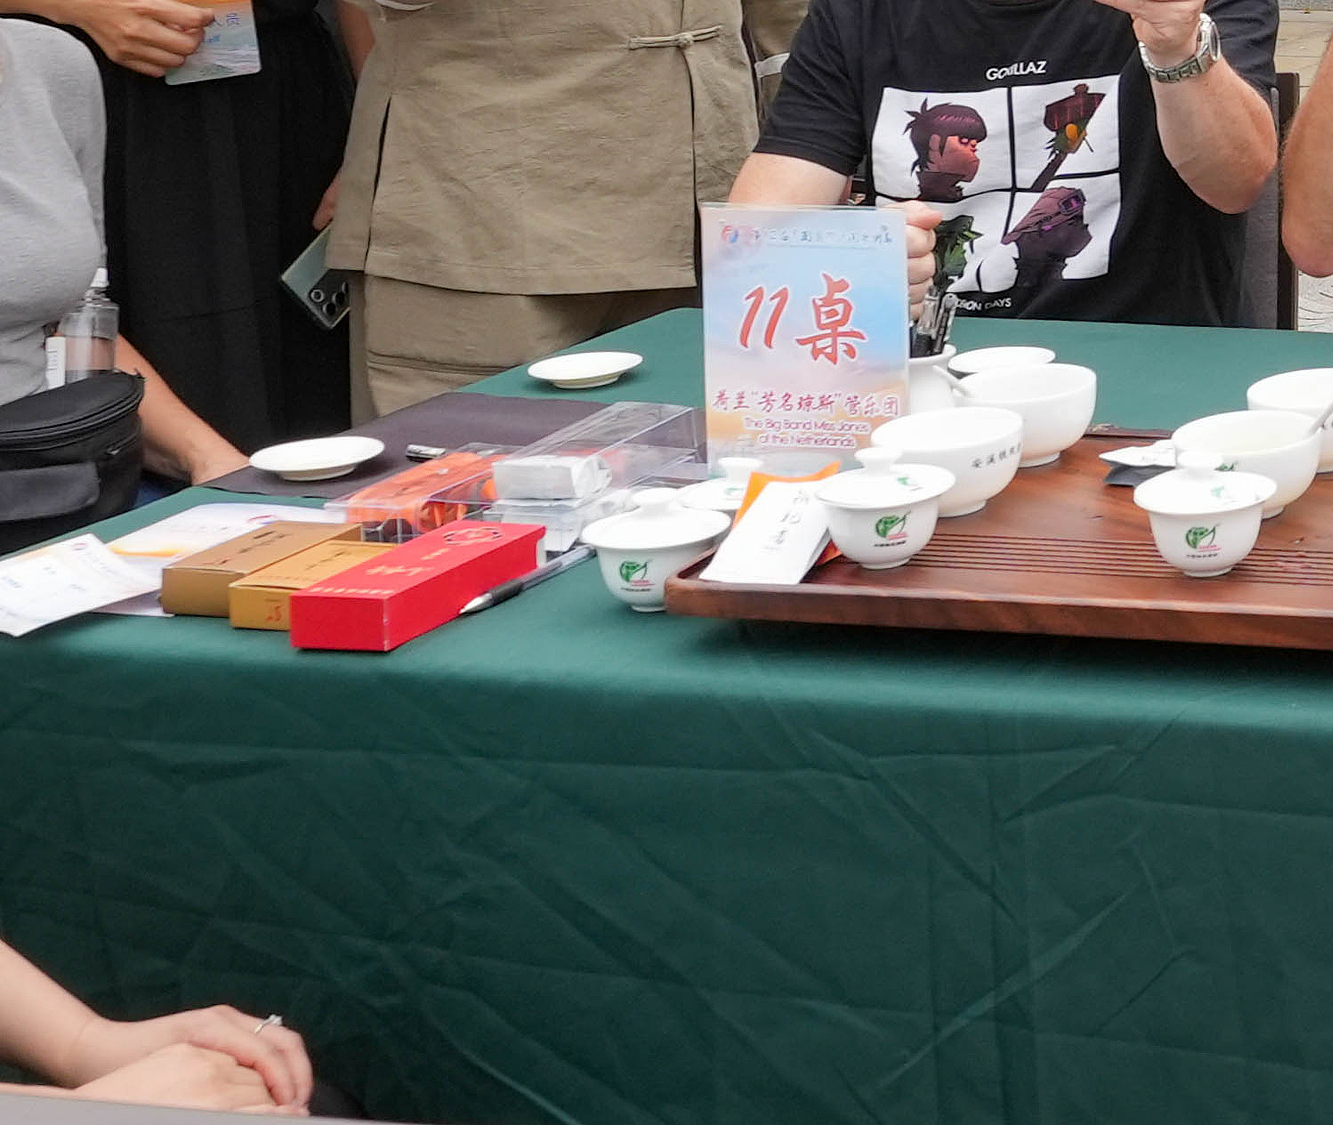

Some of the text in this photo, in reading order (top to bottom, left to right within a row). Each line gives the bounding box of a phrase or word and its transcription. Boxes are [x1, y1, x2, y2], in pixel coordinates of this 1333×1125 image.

[744, 417, 763, 429] The
[765, 419, 782, 432] Big
[784, 419, 812, 431] Band
[838, 421, 870, 434] Jones
[771, 434, 789, 445] the
[791, 435, 856, 448] Netherlands
